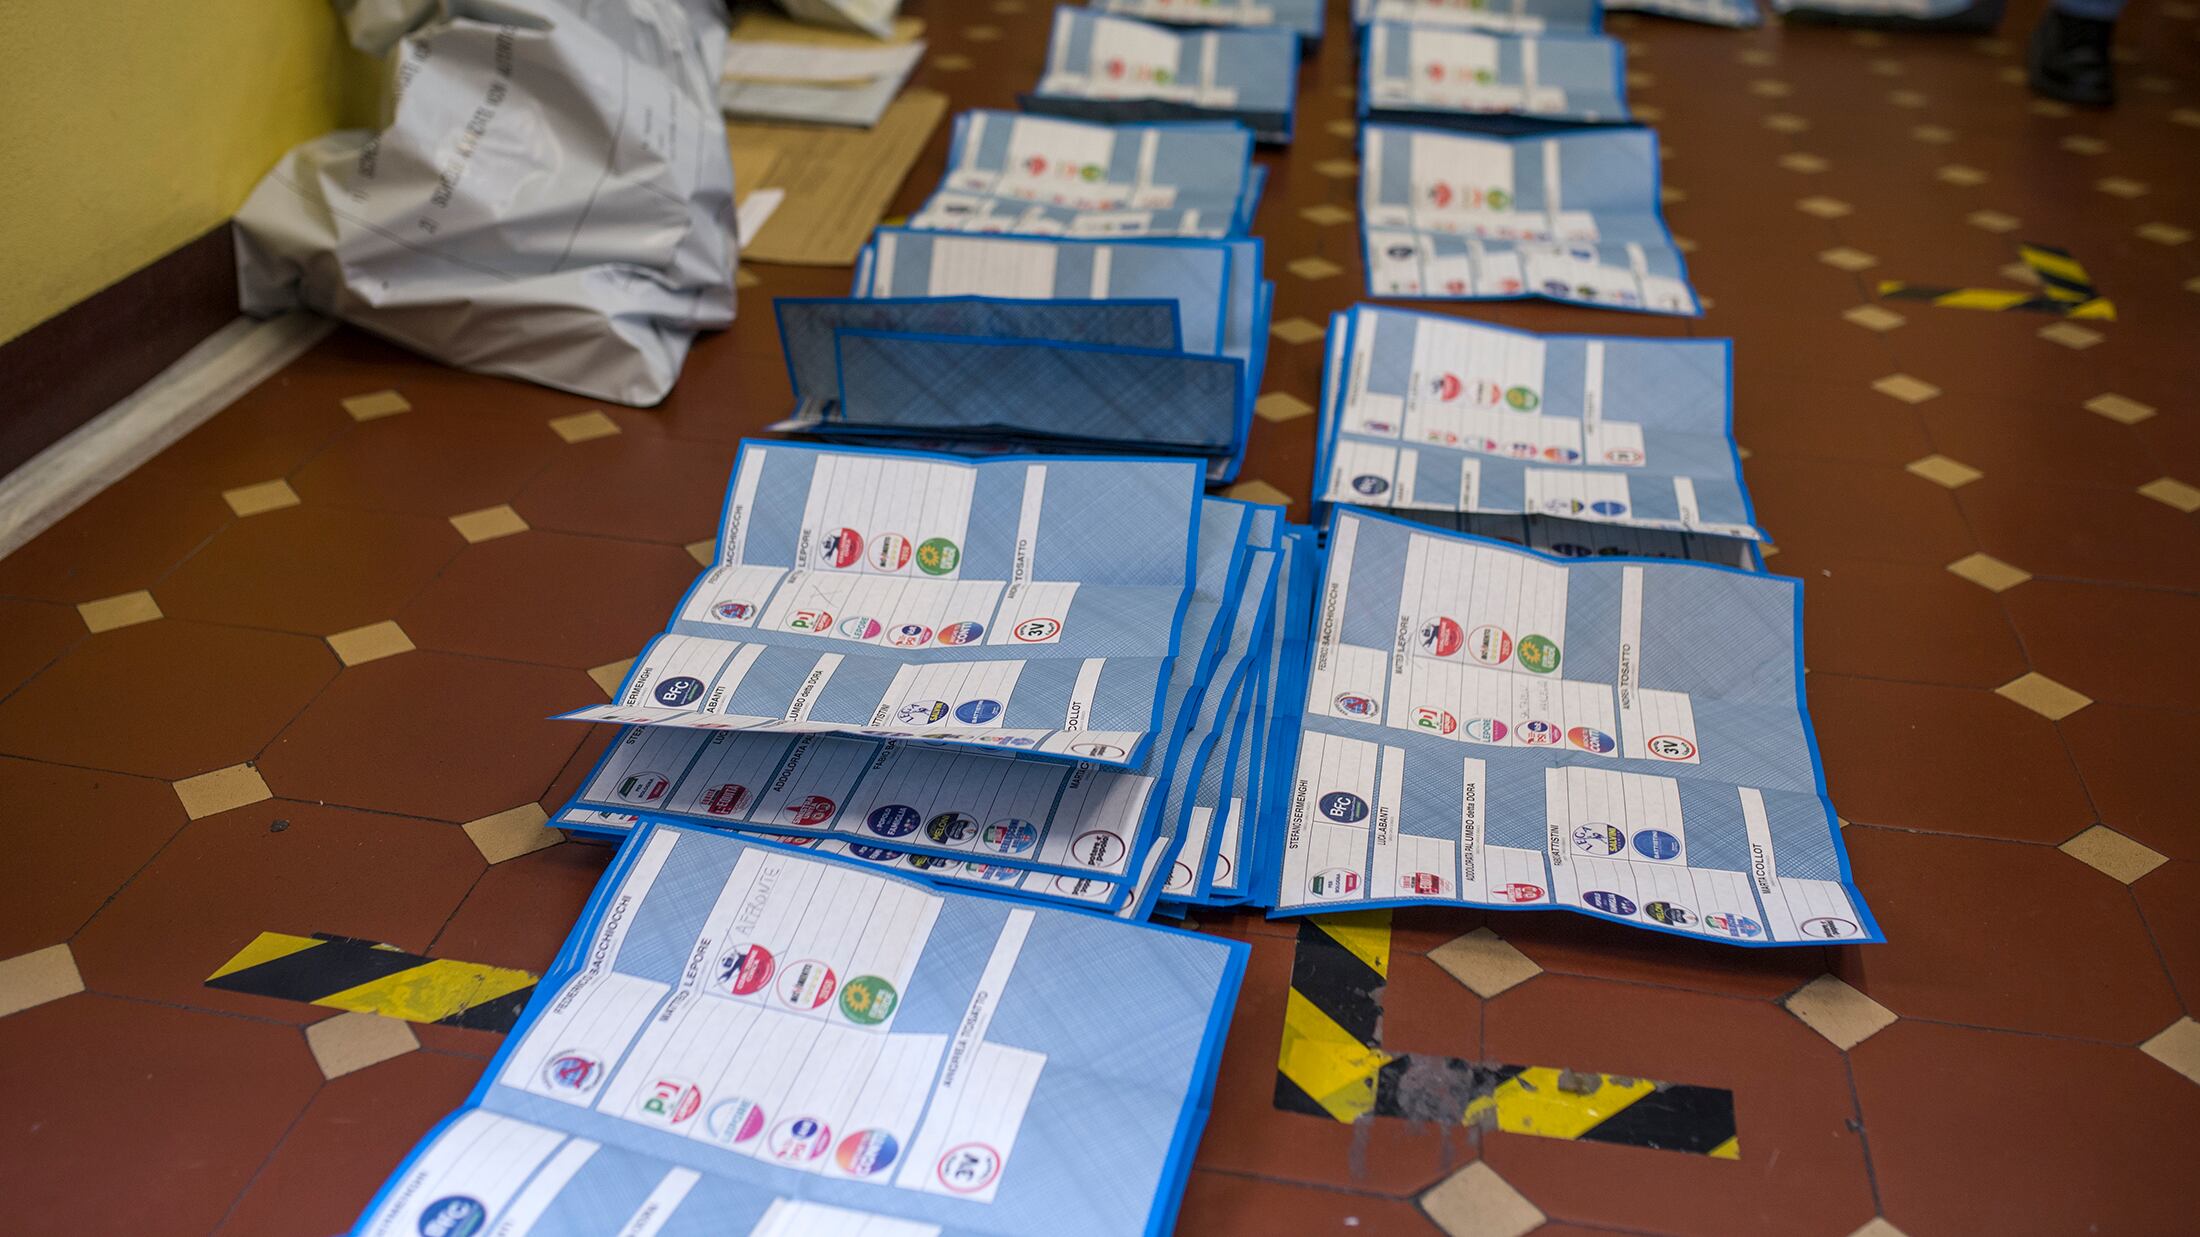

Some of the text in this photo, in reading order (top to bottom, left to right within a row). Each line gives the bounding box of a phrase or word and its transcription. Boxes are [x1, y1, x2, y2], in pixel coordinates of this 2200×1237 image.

[725, 504, 743, 567] ACCHIOCCHI
[798, 528, 812, 568] LEPORE
[1015, 538, 1028, 582] TOSATTO
[852, 616, 870, 640] LEPORE
[1027, 622, 1046, 637] 3V
[1397, 614, 1410, 652] LEPORE
[1620, 643, 1631, 688] TOSATTO
[808, 670, 824, 686] DORA
[662, 680, 690, 701] BFC
[706, 686, 726, 714] ABANTI
[871, 703, 891, 727] TTISTINI
[899, 703, 919, 724] LEGA
[1068, 701, 1082, 732] COLLOT
[626, 724, 649, 745] STEFA
[712, 730, 729, 745] LUC
[1482, 719, 1492, 743] LEPORE
[873, 747, 891, 770] FABIO
[1663, 740, 1680, 755] 3V
[773, 745, 809, 793] ADDOLORATA
[1293, 779, 1308, 824] SERMENGHI
[1466, 782, 1475, 802] DORA
[879, 808, 892, 828] POPOLO
[1330, 796, 1352, 817] BFC
[1466, 802, 1475, 819] detta
[887, 807, 908, 836] FAMIGLIA
[931, 815, 950, 840] MELONI
[1574, 826, 1593, 851] LEGA
[1608, 827, 1618, 852] SALVINI
[1752, 843, 1765, 877] COLLOT
[687, 937, 712, 988] LEPORE
